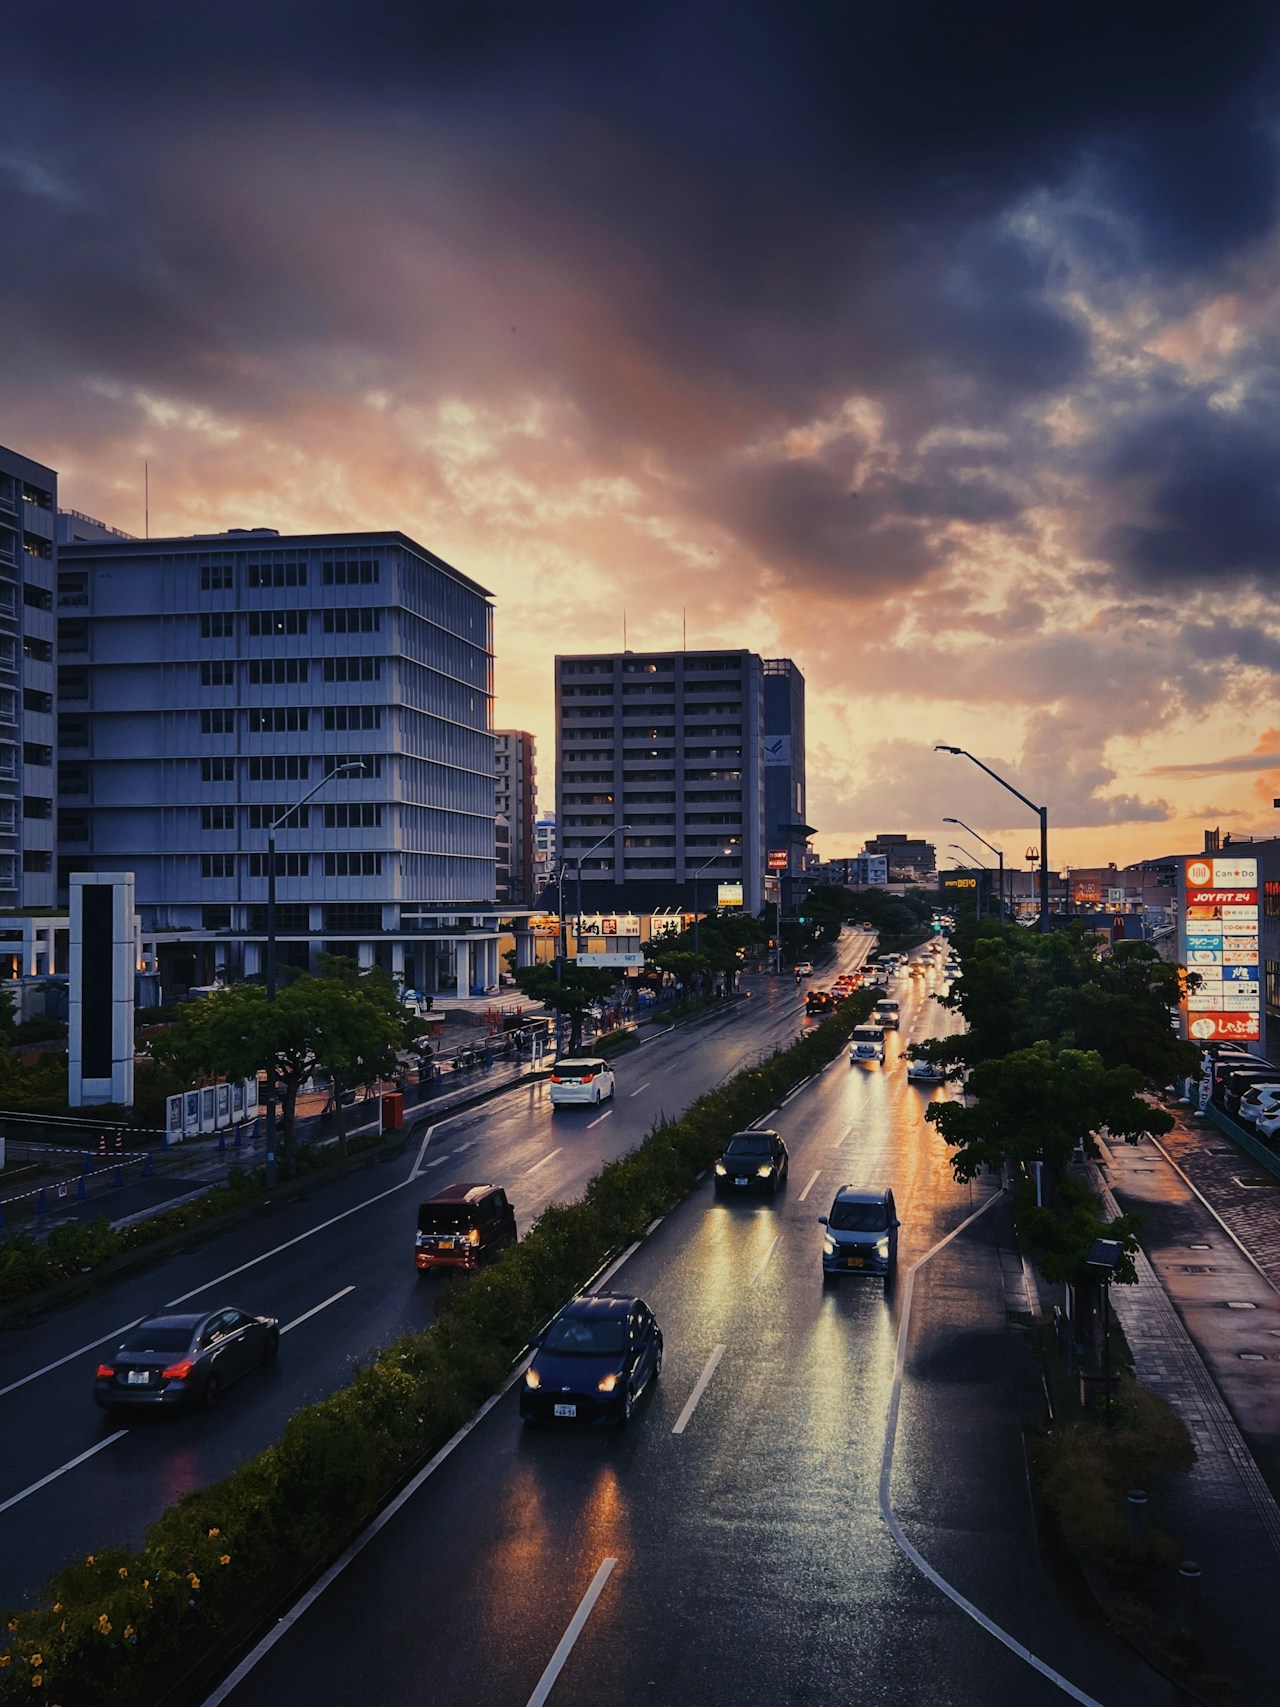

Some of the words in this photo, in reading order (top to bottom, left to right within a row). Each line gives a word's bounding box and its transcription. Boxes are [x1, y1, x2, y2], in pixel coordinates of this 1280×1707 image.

[1192, 868, 1206, 878] 100
[1194, 894, 1216, 902] JOY
[1235, 894, 1250, 902] 24
